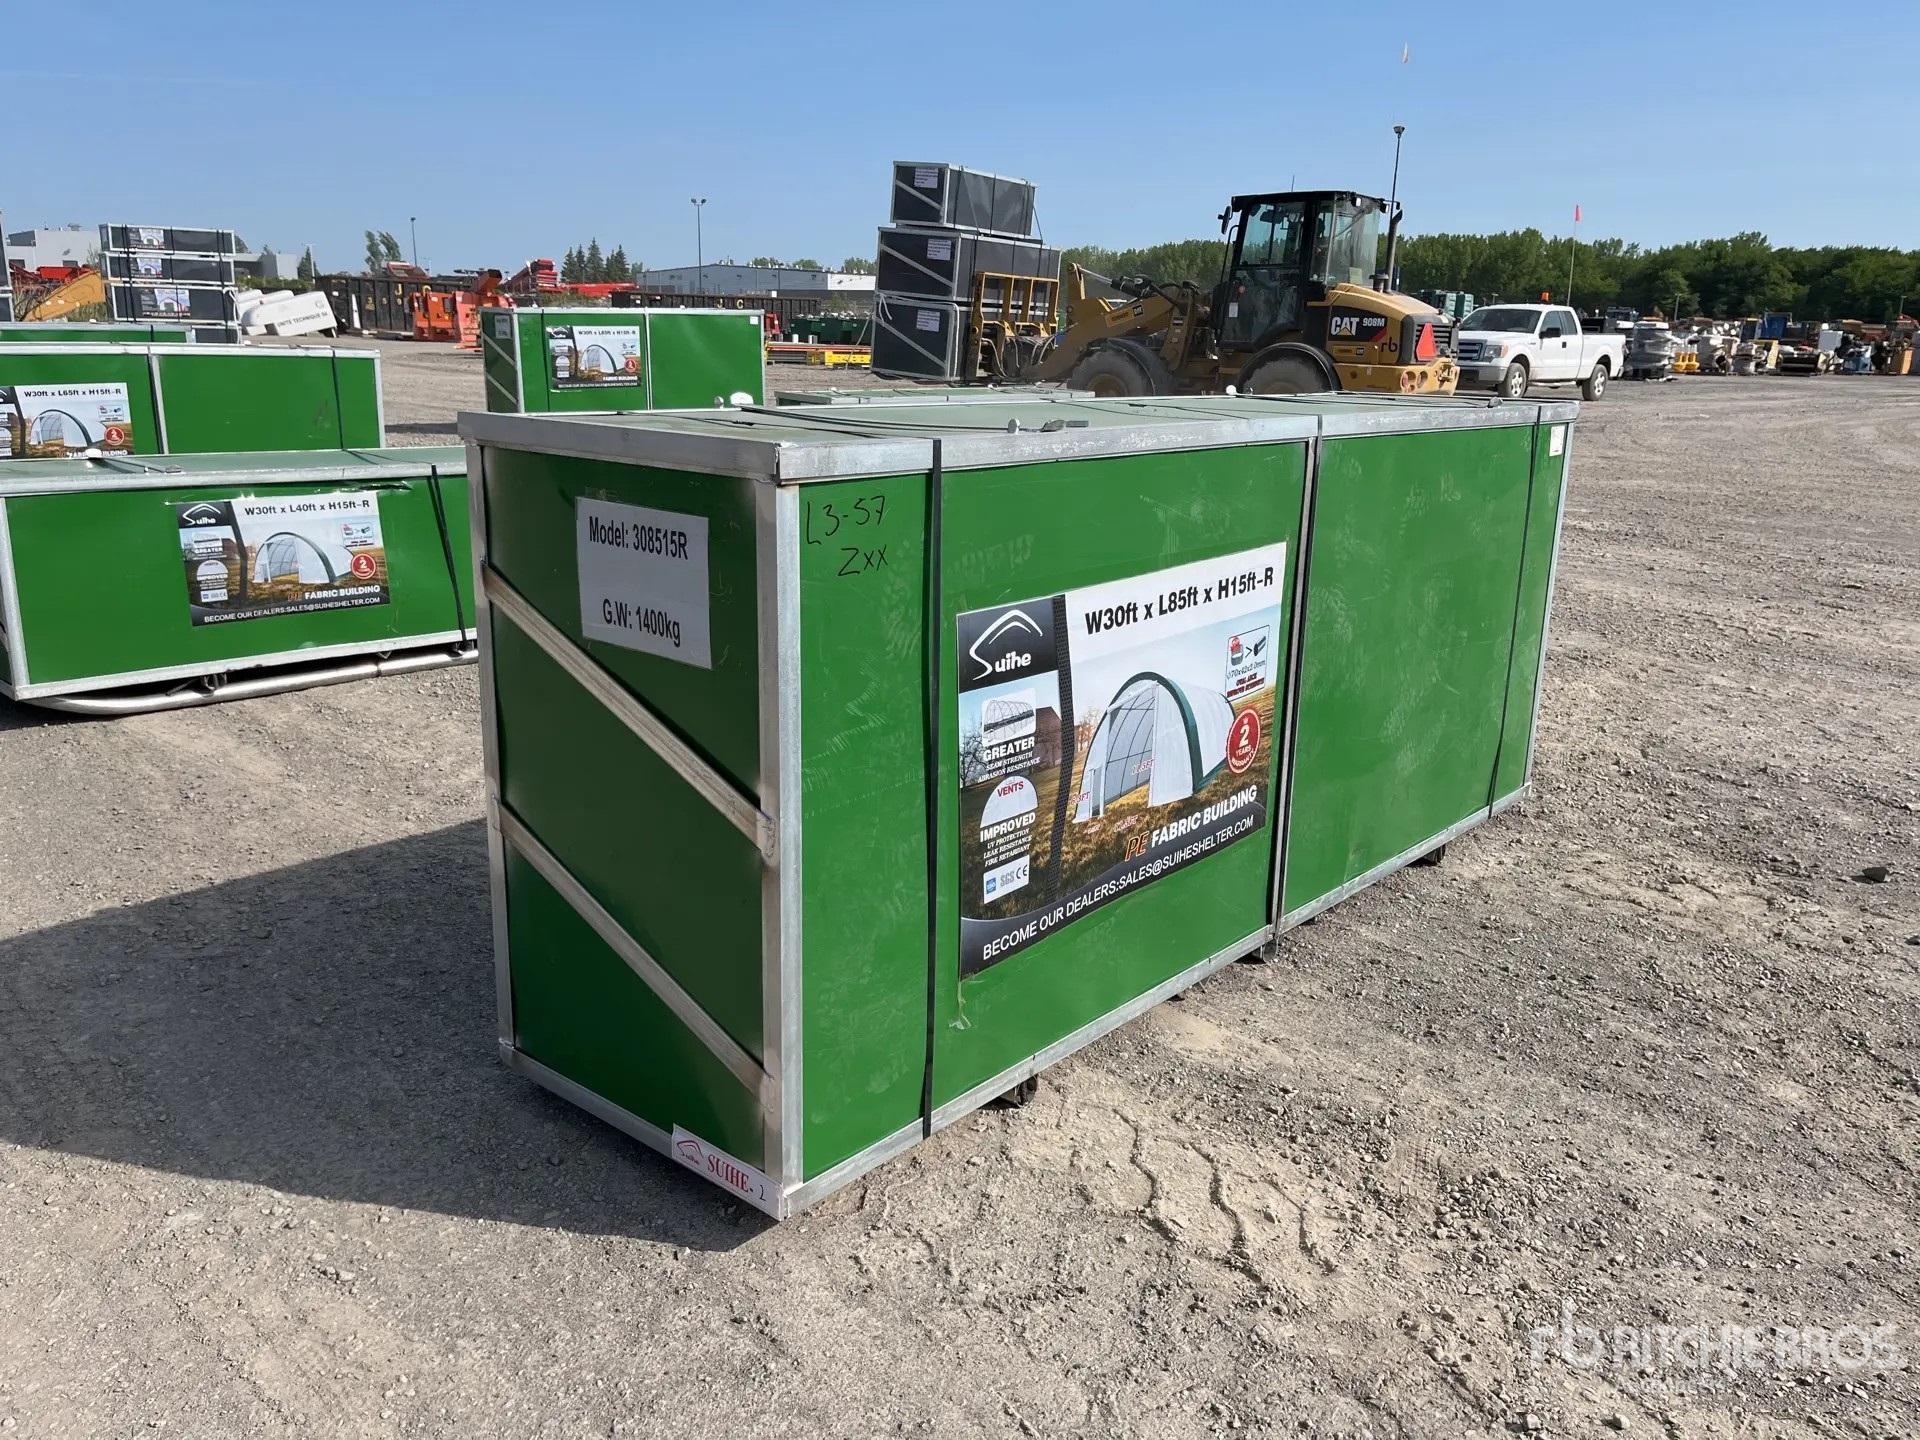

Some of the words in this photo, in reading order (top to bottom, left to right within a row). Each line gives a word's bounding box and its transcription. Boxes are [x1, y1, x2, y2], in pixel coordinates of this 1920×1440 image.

[1331, 316, 1360, 336] CAT
[1363, 317, 1385, 327] 908M
[1381, 336, 1398, 353] rb
[245, 505, 276, 516] W30ft
[289, 502, 316, 513] L40ft
[328, 499, 370, 510] H15ft-R
[589, 516, 629, 549] Model:
[633, 524, 688, 560] 308515R
[360, 558, 367, 569] 2
[304, 590, 339, 600] FABRIC
[339, 584, 380, 597] BUILDING
[1085, 602, 1138, 635] W30ft
[1143, 603, 1153, 620] x
[1159, 586, 1198, 616] L85ft
[1203, 587, 1212, 604] x
[1217, 566, 1274, 600] H15ft-R
[204, 612, 236, 623] BECOME
[237, 610, 253, 621] OUR
[603, 598, 633, 629] G.W:
[636, 606, 681, 648] 1400kg
[1239, 724, 1250, 748] 2
[983, 736, 1035, 762] GREATER
[1232, 748, 1255, 767] WARRANTY
[1236, 745, 1252, 757] YEARS
[978, 768, 1006, 783] ABRASION
[1006, 756, 1041, 774] RESISTANCE
[986, 761, 1002, 771] SEAM
[1002, 751, 1033, 766] STRENGTH
[997, 781, 1024, 798] VENTS
[980, 812, 1036, 843] IMPROVED
[1124, 831, 1150, 862] PE
[1151, 812, 1201, 848] FABRIC
[1202, 784, 1258, 826] BUILDING
[983, 848, 998, 859] LEAK
[999, 834, 1032, 853] RESISTANCE
[987, 841, 995, 849] UV
[995, 828, 1030, 847] PROTECTION
[985, 856, 998, 867] FIRE
[998, 843, 1031, 861] RETARDANT
[983, 920, 1038, 960] BECOME
[1039, 906, 1064, 931] OUR
[1066, 814, 1254, 917] DEALERS:SALES@SUIHESHELTER.COM
[1000, 870, 1015, 888] SGS
